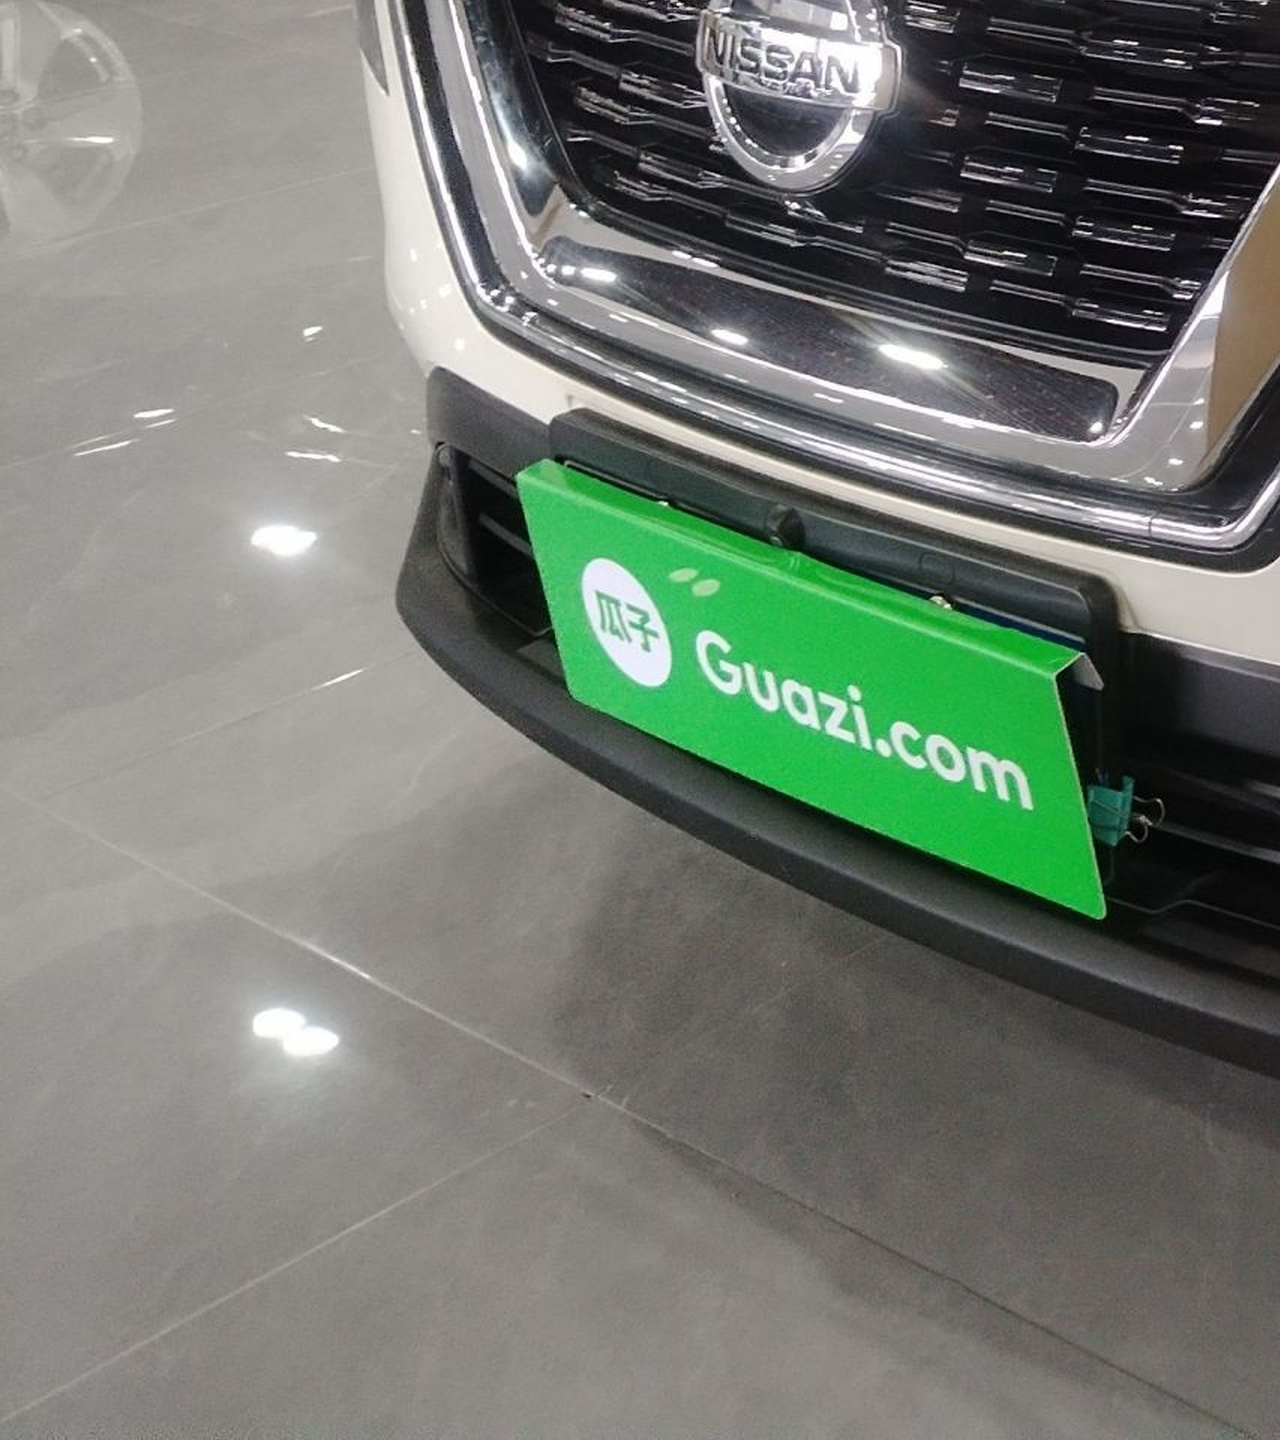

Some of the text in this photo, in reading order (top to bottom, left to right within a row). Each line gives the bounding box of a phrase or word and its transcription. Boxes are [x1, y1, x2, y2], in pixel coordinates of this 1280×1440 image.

[704, 26, 860, 93] NISSAN
[595, 591, 659, 652] 瓜子
[695, 630, 1033, 810] Guazi.com
